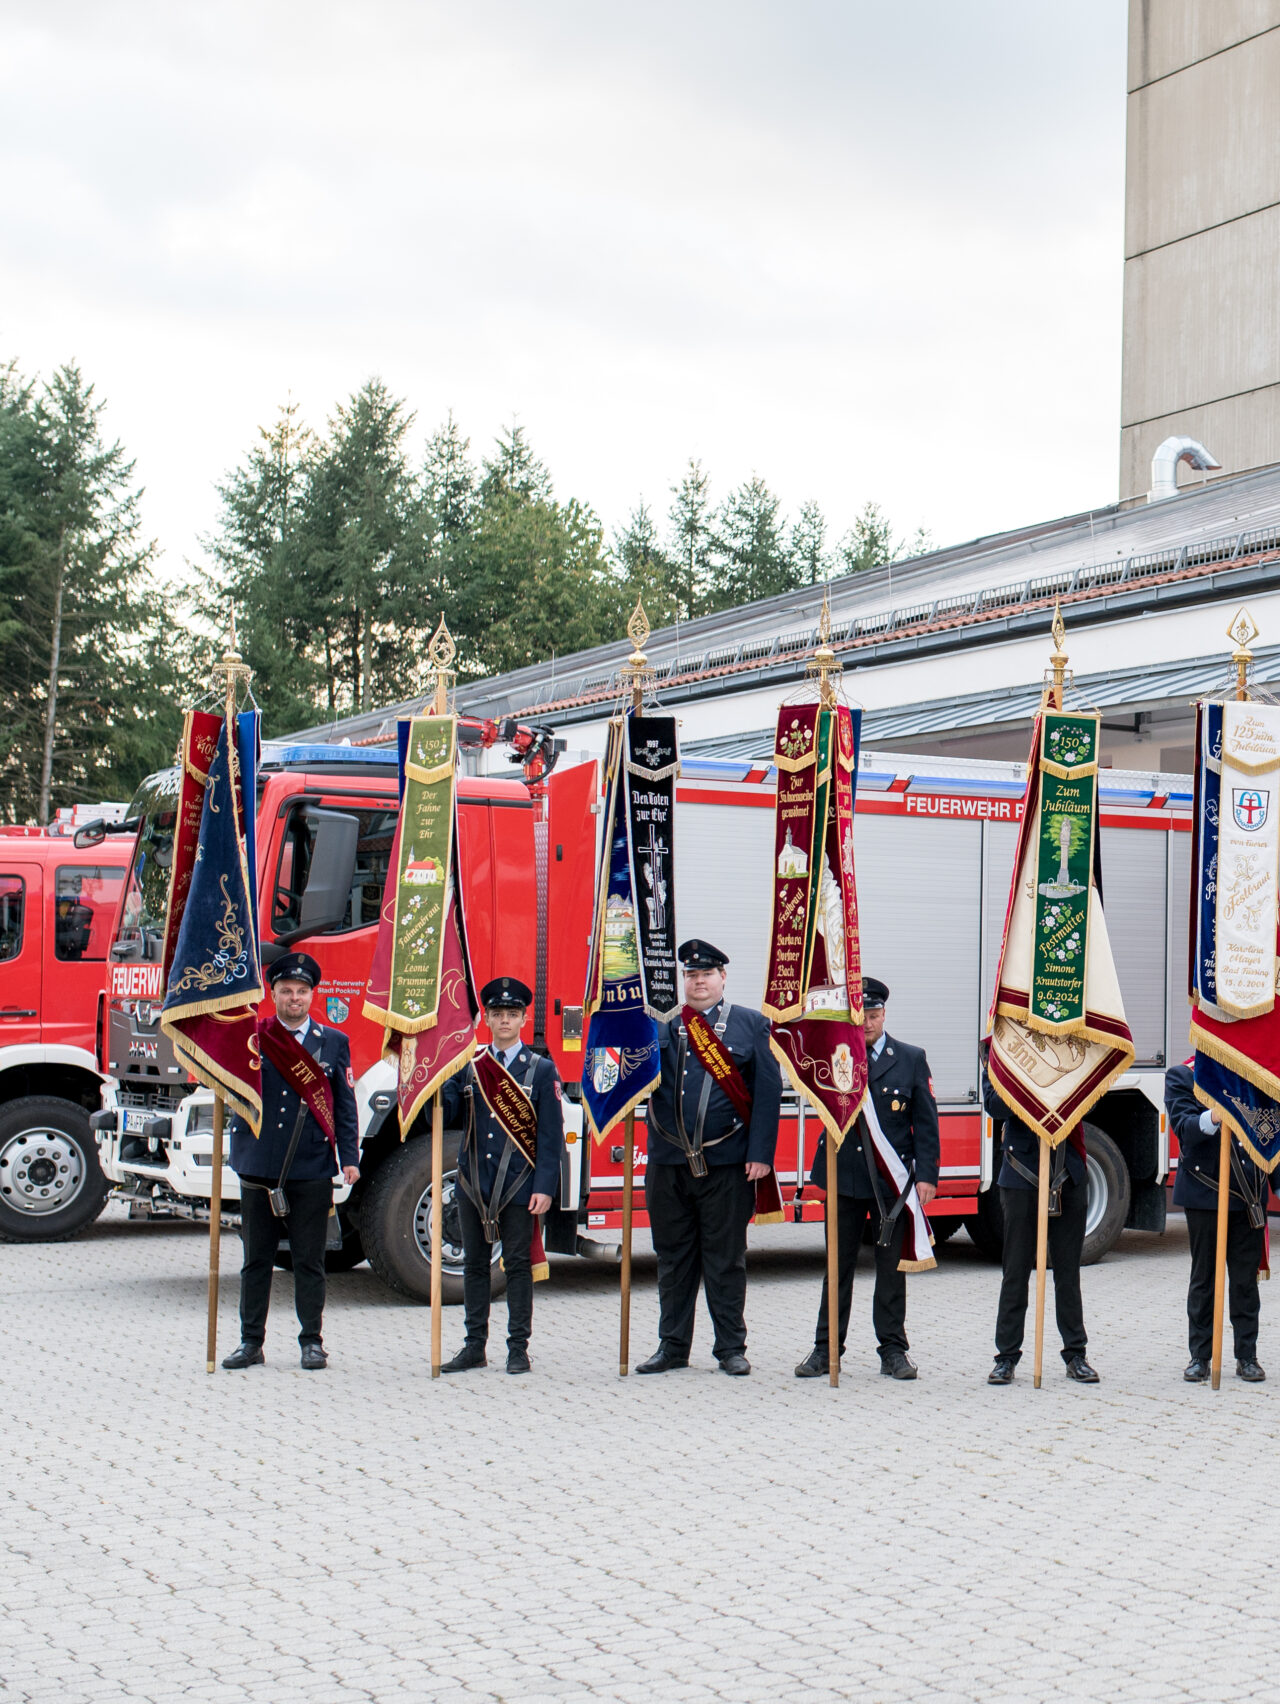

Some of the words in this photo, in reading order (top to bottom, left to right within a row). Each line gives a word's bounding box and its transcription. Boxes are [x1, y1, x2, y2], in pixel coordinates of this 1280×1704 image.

[1244, 716, 1265, 727] Zum
[1232, 725, 1255, 739] 125
[425, 740, 440, 750] 150
[1060, 737, 1080, 749] 150
[1230, 739, 1277, 755] Jubiläum
[421, 791, 438, 800] Der
[632, 790, 648, 805] Den
[648, 791, 669, 806] Toten
[1056, 785, 1080, 797] Zum
[416, 803, 441, 815] Fahne
[906, 796, 1011, 818] FEUERWEHR
[1042, 799, 1091, 814] Jubiläum
[420, 818, 435, 826] zur
[636, 810, 651, 822] zur
[1223, 871, 1272, 920] Festbraut
[779, 886, 805, 929] Festbraut
[398, 903, 441, 949] Fahnenbraut
[1039, 910, 1086, 958] Festmutter
[403, 963, 430, 973] Leonie
[1044, 963, 1076, 974] Simone
[111, 966, 162, 996] FEUERW
[1035, 976, 1083, 991] Krautstorfer
[405, 988, 426, 997] 2022
[605, 984, 643, 1003] nbu
[1037, 990, 1080, 1004] 9.6.2024
[707, 1043, 732, 1075] Feuerwehr
[290, 1060, 317, 1086] FFW
[498, 1078, 532, 1122] Freiwillige
[493, 1093, 527, 1132] Ruhstorf
